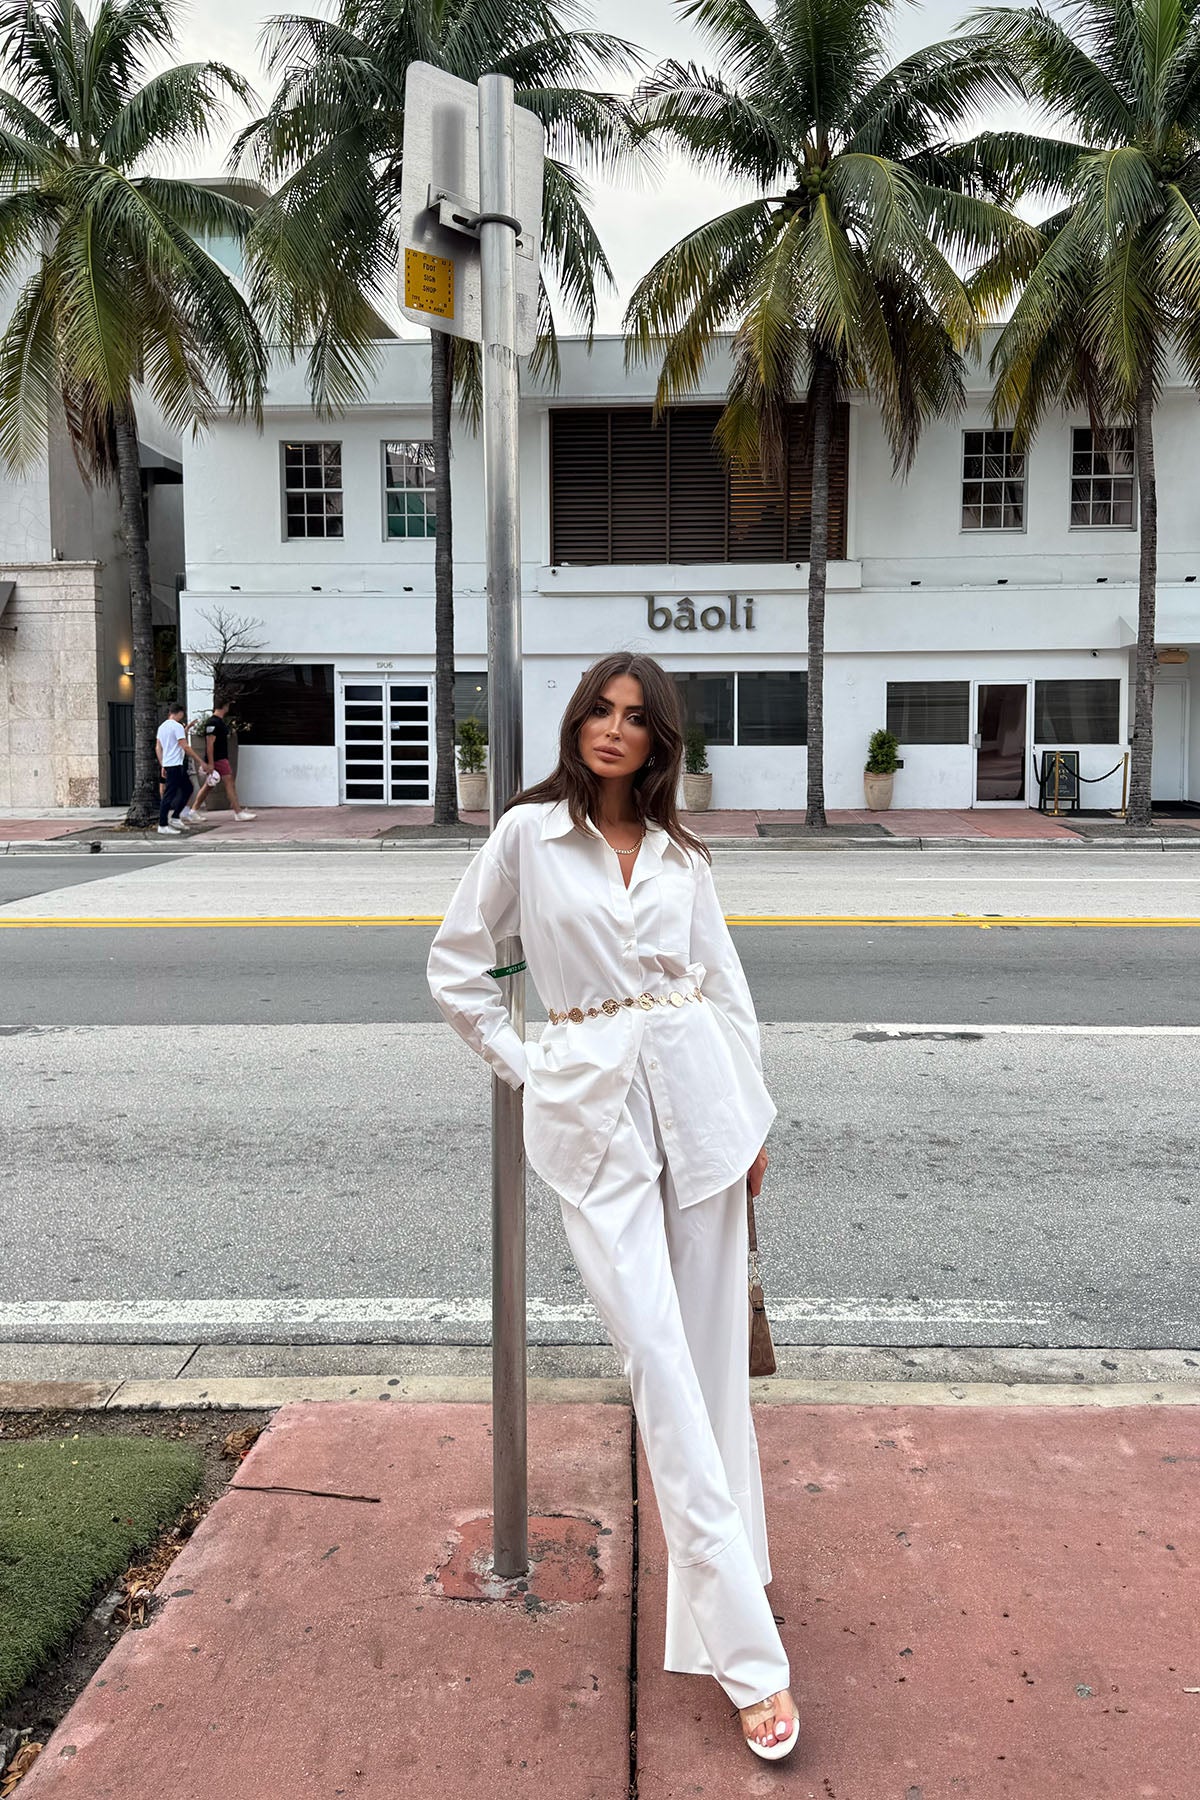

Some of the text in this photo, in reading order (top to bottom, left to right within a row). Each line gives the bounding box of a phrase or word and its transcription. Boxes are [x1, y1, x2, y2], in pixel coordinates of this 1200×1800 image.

[422, 262, 436, 272] FDOT
[424, 274, 436, 283] SIGN
[422, 285, 437, 294] SHOP
[645, 594, 755, 631] bâoli
